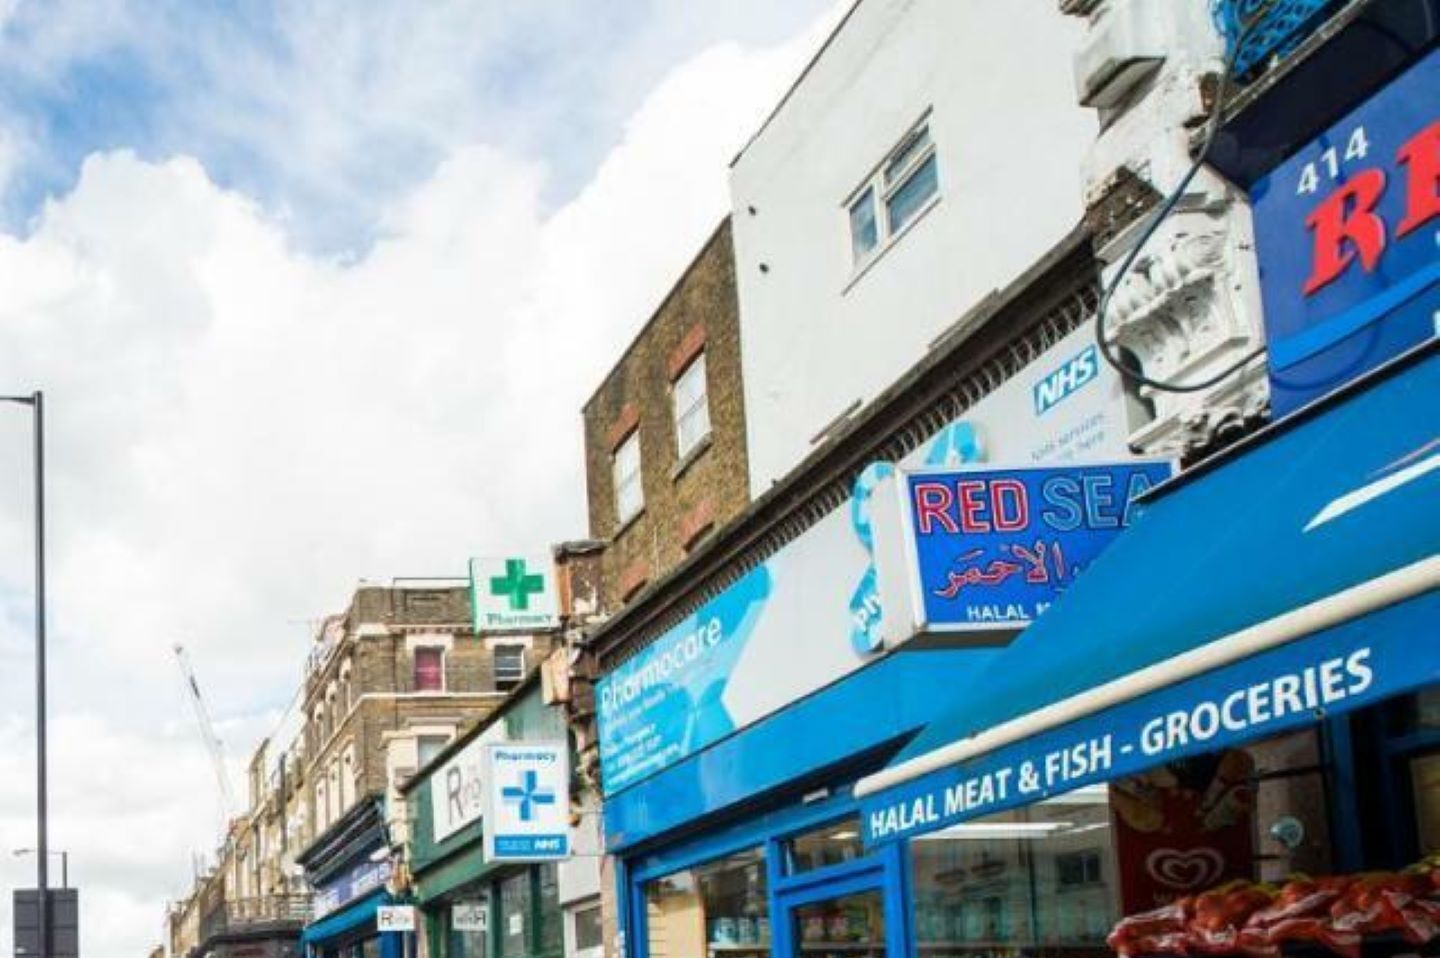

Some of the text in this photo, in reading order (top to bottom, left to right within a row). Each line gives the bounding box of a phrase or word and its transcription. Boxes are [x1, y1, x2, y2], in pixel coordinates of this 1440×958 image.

[1297, 126, 1369, 194] 414
[1037, 350, 1095, 411] NHS
[915, 480, 1028, 533] RED
[486, 613, 553, 626] Pharmacy
[967, 603, 1030, 622] HALAL
[495, 751, 557, 764] Pharmacy
[870, 795, 940, 838] HALAL
[944, 768, 1012, 813] MEAT
[1017, 762, 1040, 794] &
[1045, 733, 1112, 787] FISH
[1140, 647, 1374, 757] GROCERIES
[533, 837, 561, 851] NHS
